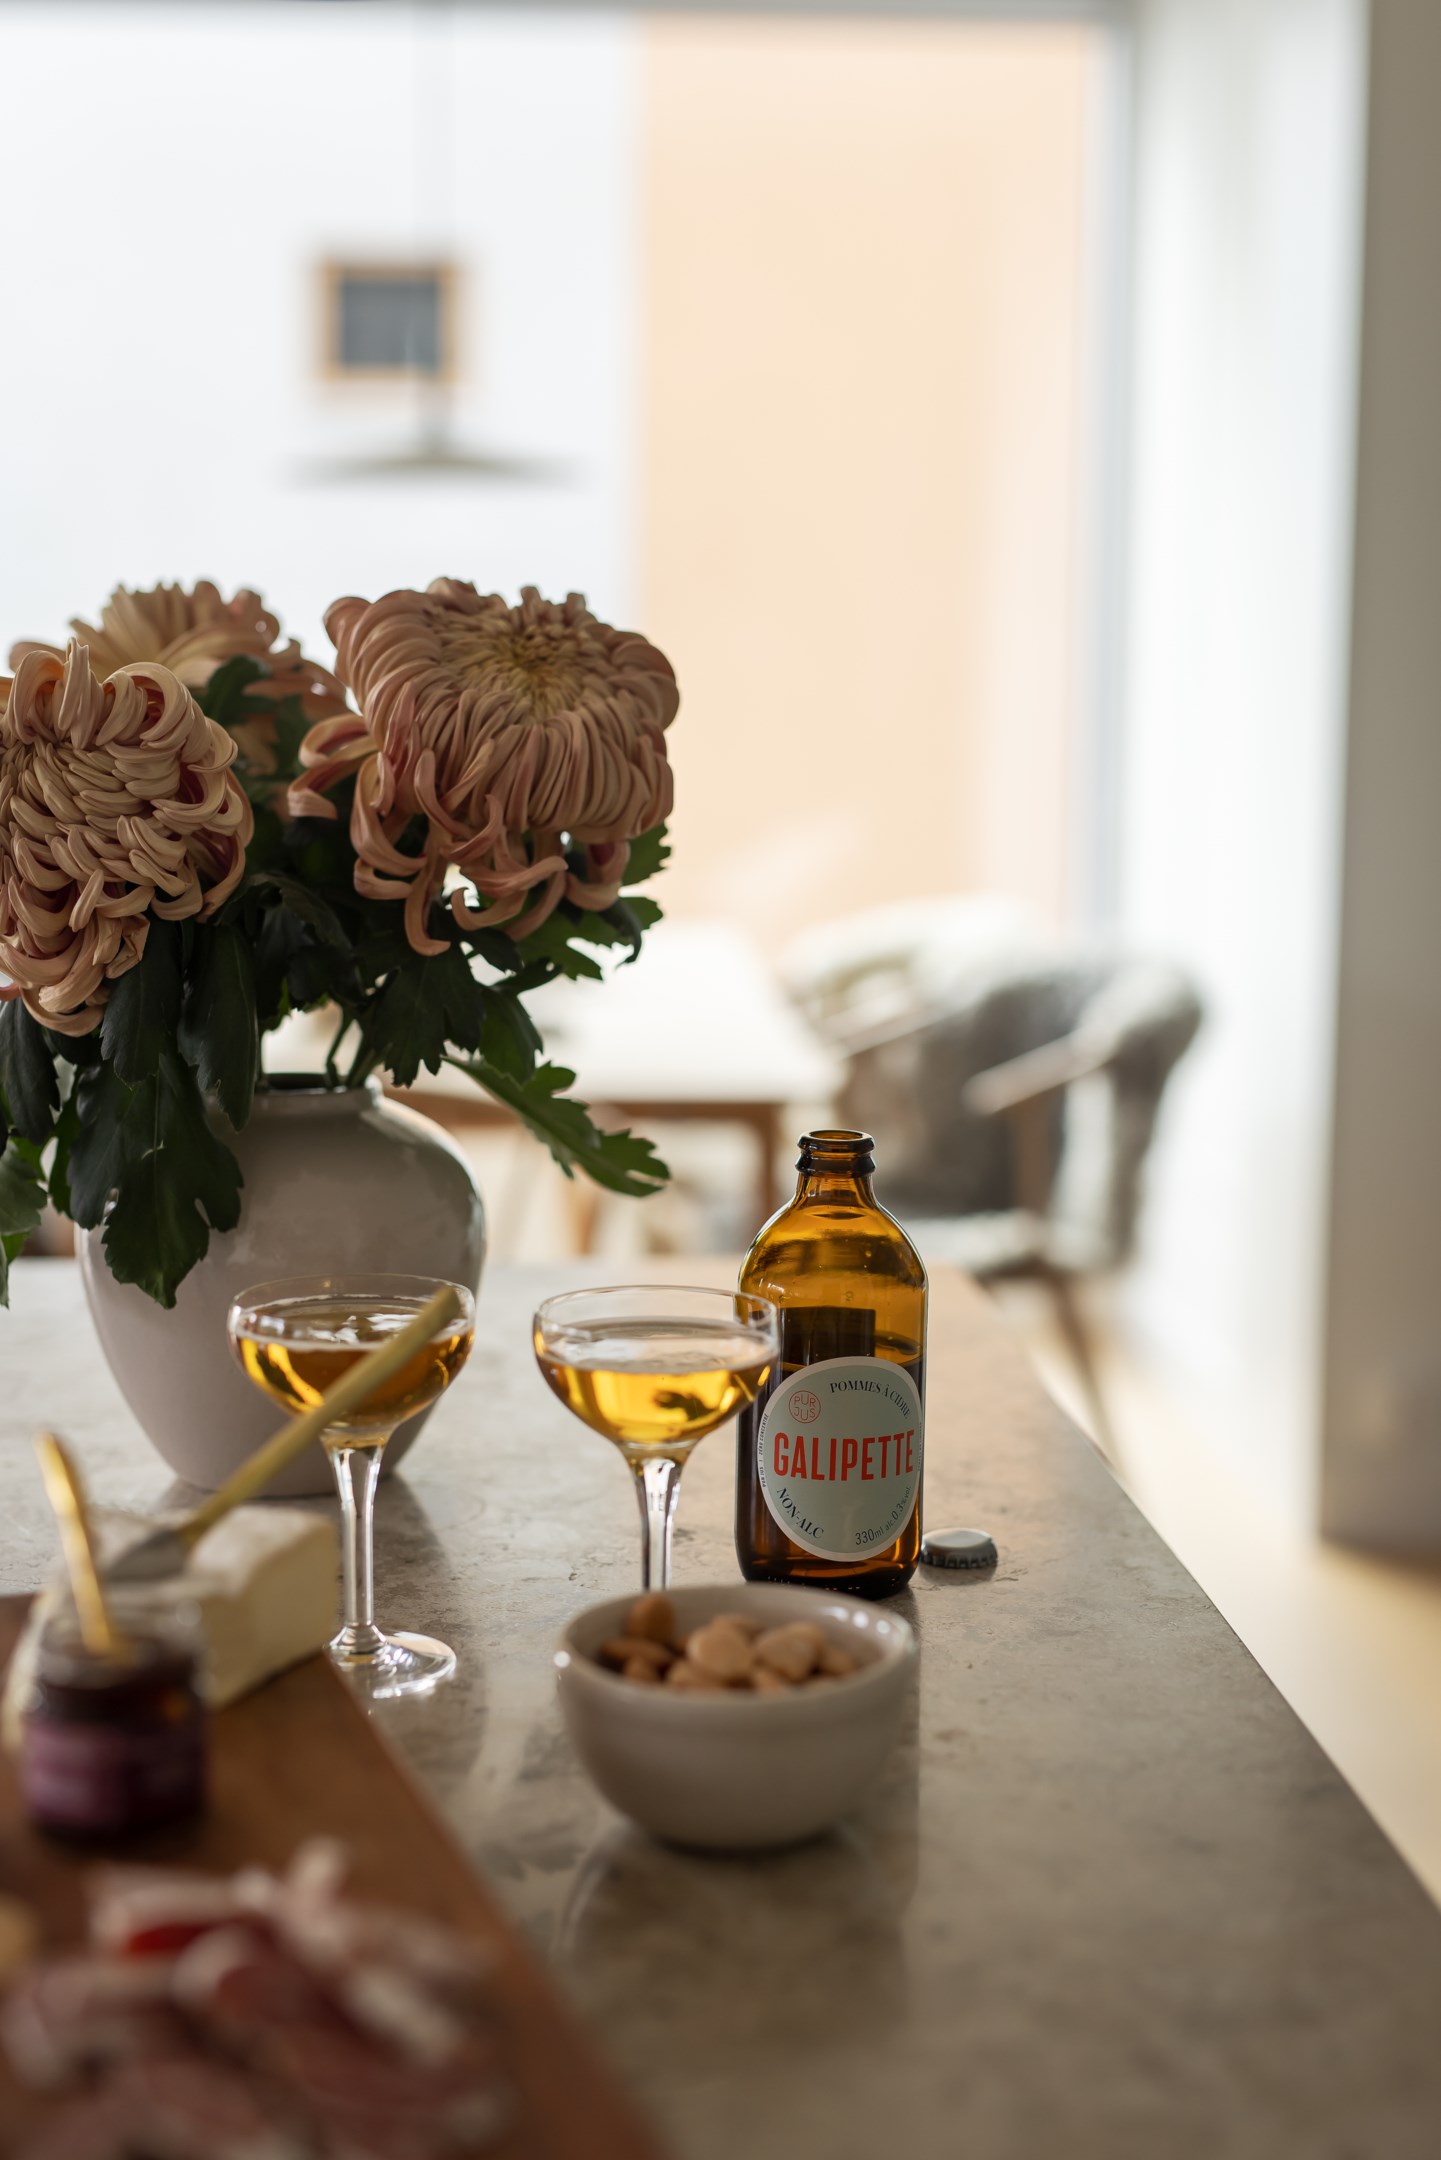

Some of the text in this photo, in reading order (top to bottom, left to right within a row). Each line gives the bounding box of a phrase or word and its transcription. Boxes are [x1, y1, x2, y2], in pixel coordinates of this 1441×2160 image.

[794, 1393, 816, 1408] PUR
[794, 1406, 816, 1421] JUS
[829, 1380, 911, 1419] POMMES À CIDRE
[773, 1429, 915, 1481] GALIPETTE
[777, 1488, 825, 1539] NON-ALC
[855, 1526, 885, 1545] 330ml
